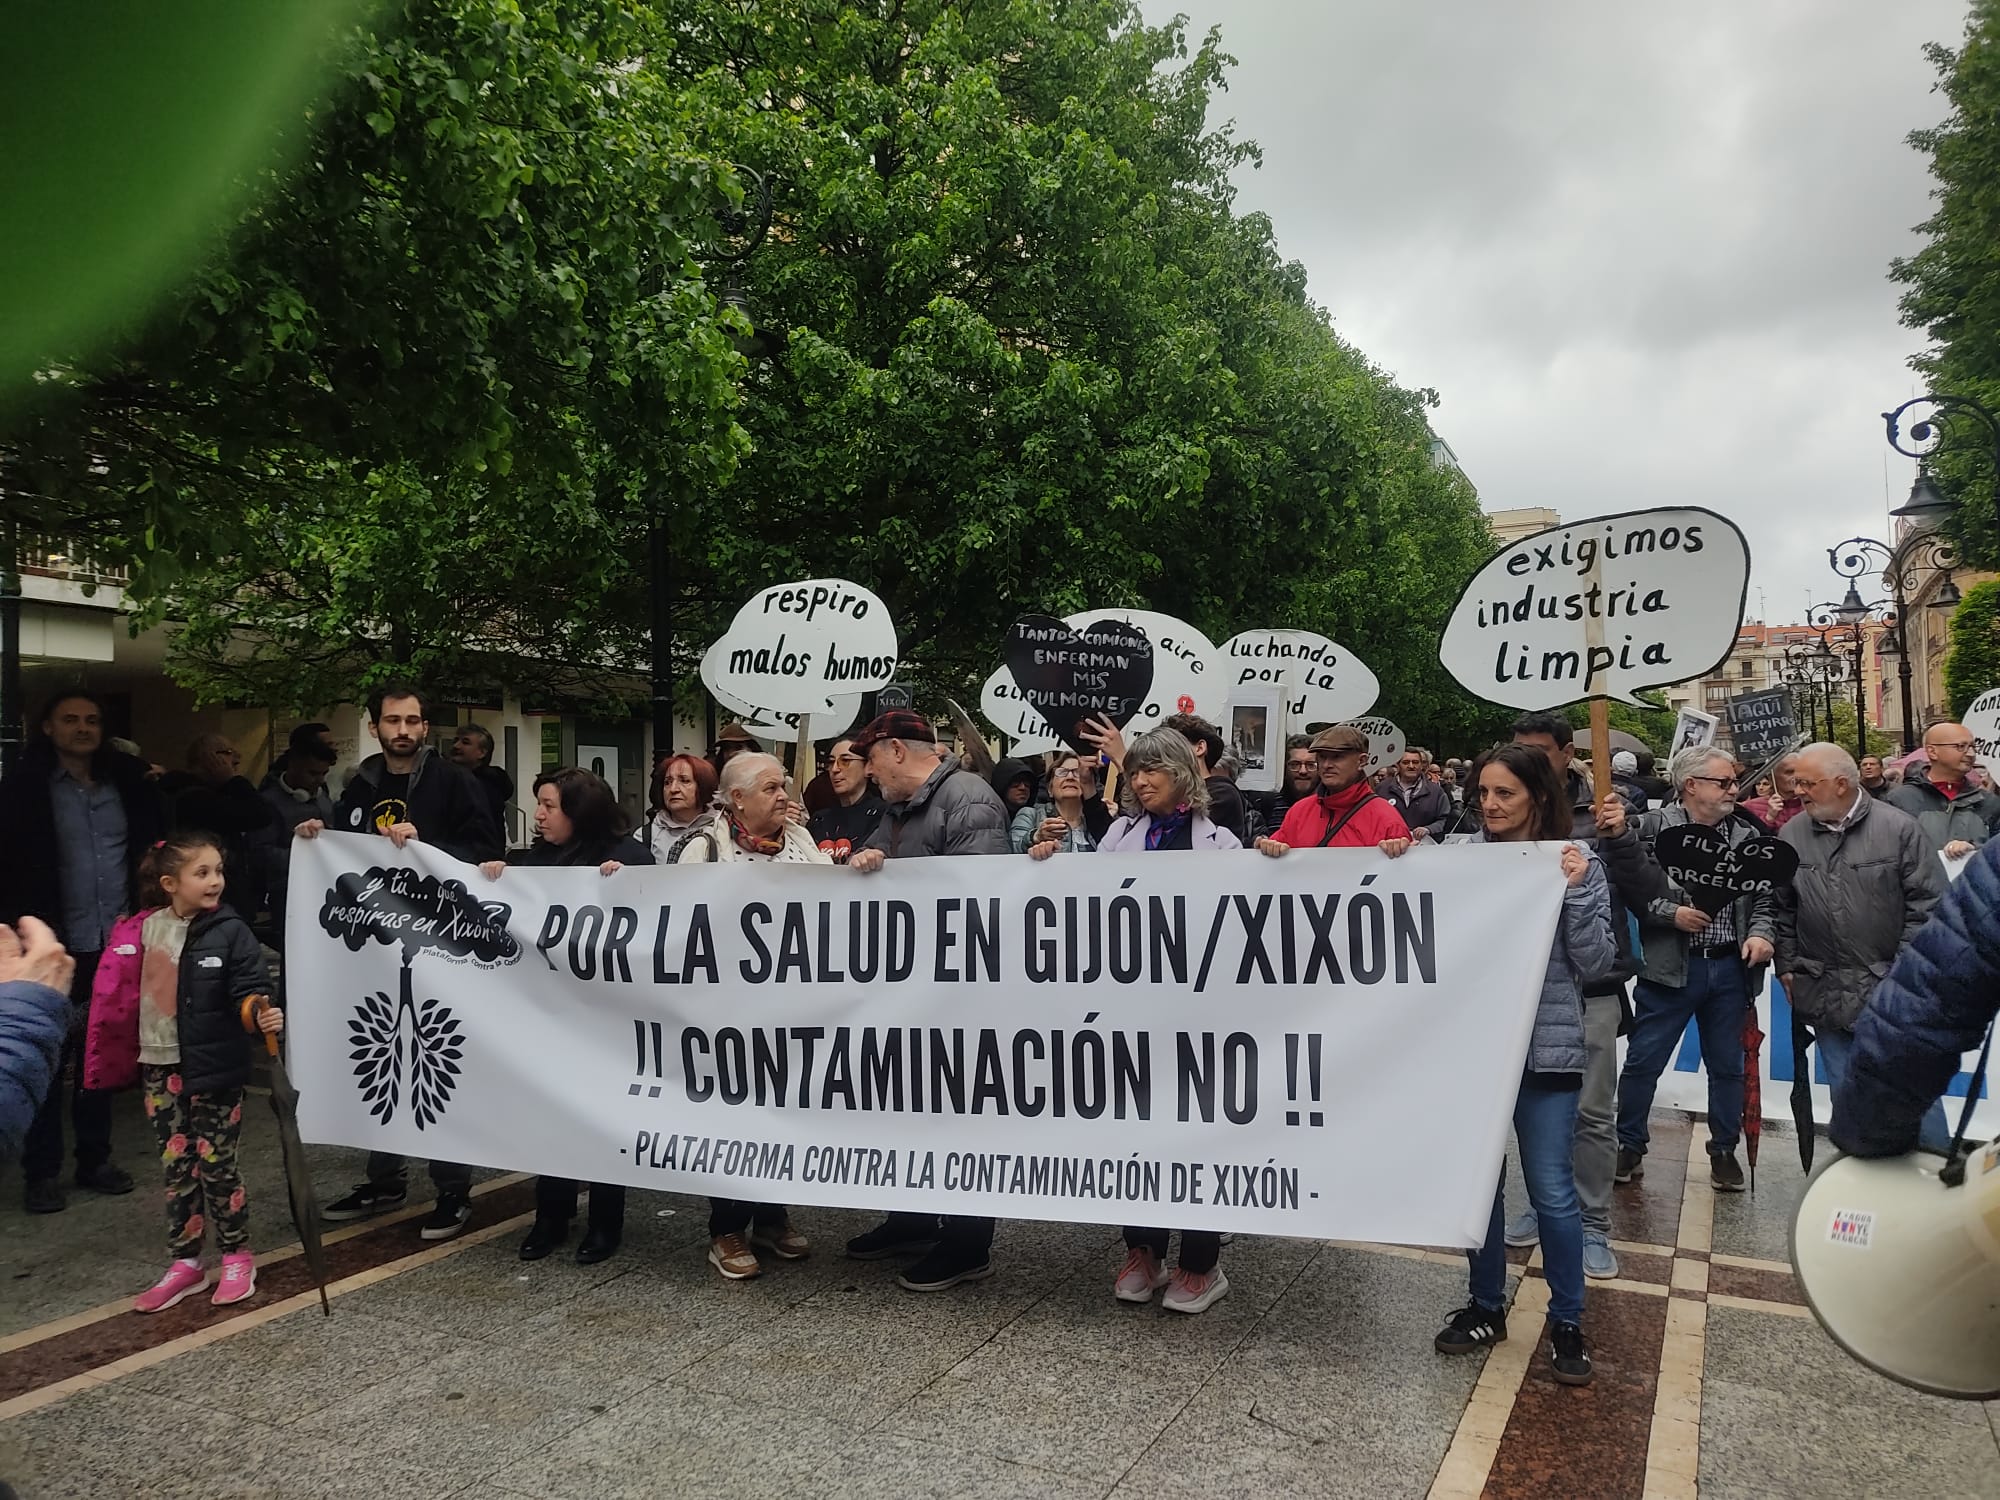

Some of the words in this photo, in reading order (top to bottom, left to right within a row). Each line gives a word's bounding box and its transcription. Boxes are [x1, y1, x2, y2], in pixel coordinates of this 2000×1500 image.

[1506, 525, 1704, 576] exigimos
[763, 584, 869, 621] respiro
[1477, 581, 1670, 629] industria
[1016, 623, 1080, 645] TANTOS
[1230, 636, 1337, 668] luchando
[729, 633, 812, 677] malos
[823, 642, 896, 681] humos
[1033, 649, 1130, 670] ENFERMAN
[1160, 637, 1205, 675] aire
[1494, 635, 1672, 693] limpia
[1238, 667, 1286, 685] por
[1027, 688, 1138, 717] PULMONES
[1667, 866, 1774, 895] ARCELOR
[1714, 862, 1744, 874] EN
[328, 902, 412, 936] respiras
[412, 917, 438, 936] en
[537, 903, 639, 984] POR
[653, 903, 721, 985] LA
[739, 899, 916, 985] SALUD
[933, 897, 1001, 983] EN
[1023, 875, 1438, 993] GIJÓN/XIXÓN
[628, 1019, 663, 1098] !!
[680, 1012, 1151, 1121] CONTAMINACIÓN
[1176, 1031, 1259, 1126] NO
[1284, 1033, 1325, 1128] !!
[635, 1130, 795, 1181] PLATAFORMA
[802, 1145, 898, 1188] CONTRA
[905, 1150, 935, 1190] LA
[944, 1152, 1161, 1203] CONTAMINACIÓN
[1170, 1161, 1204, 1206] DE
[1212, 1158, 1300, 1210] XIXÓN
